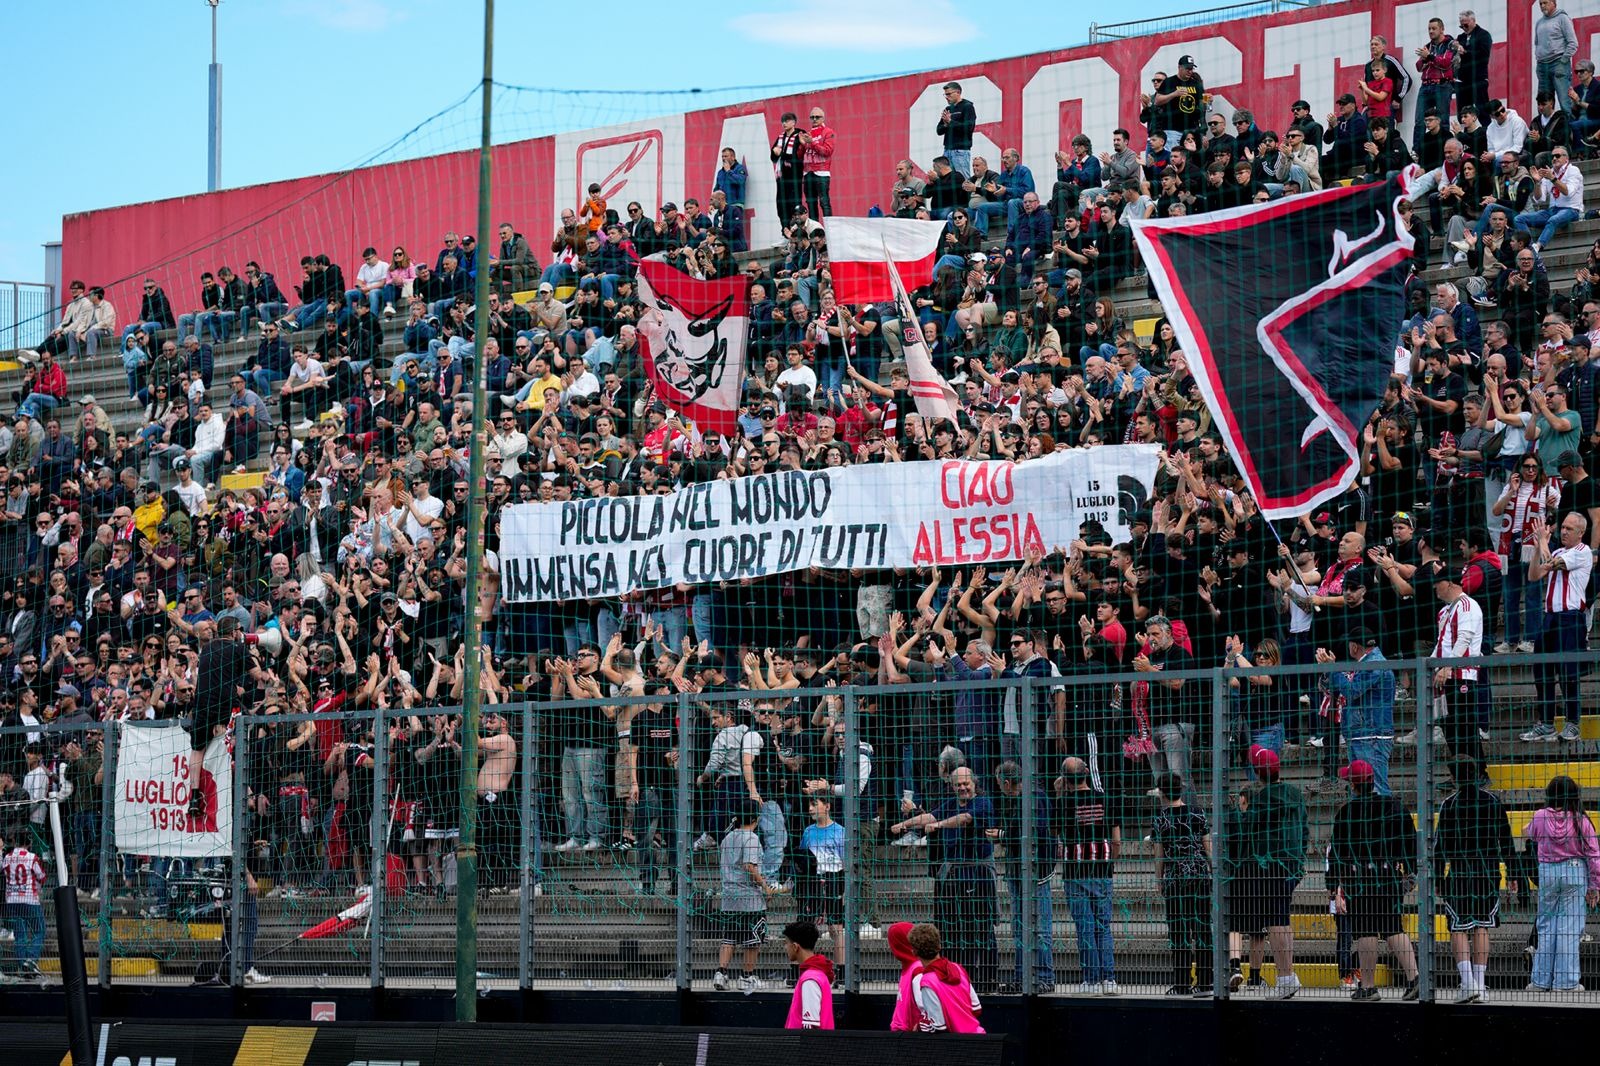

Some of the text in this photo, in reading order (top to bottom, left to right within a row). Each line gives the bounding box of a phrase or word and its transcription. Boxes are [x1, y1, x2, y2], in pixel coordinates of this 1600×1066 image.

[941, 460, 1015, 509] CIAO
[1088, 480, 1100, 491] 15
[560, 470, 832, 546] PICCOLA NEL MONDO
[1077, 495, 1115, 508] LUGLIO
[1084, 511, 1108, 522] 1913
[913, 512, 1047, 565] ALESSIA
[505, 523, 888, 601] IMMENSA NEL CUORE DI TUTTI
[173, 754, 189, 780] 15
[126, 779, 188, 806] LUGLIO
[150, 808, 186, 832] 1913
